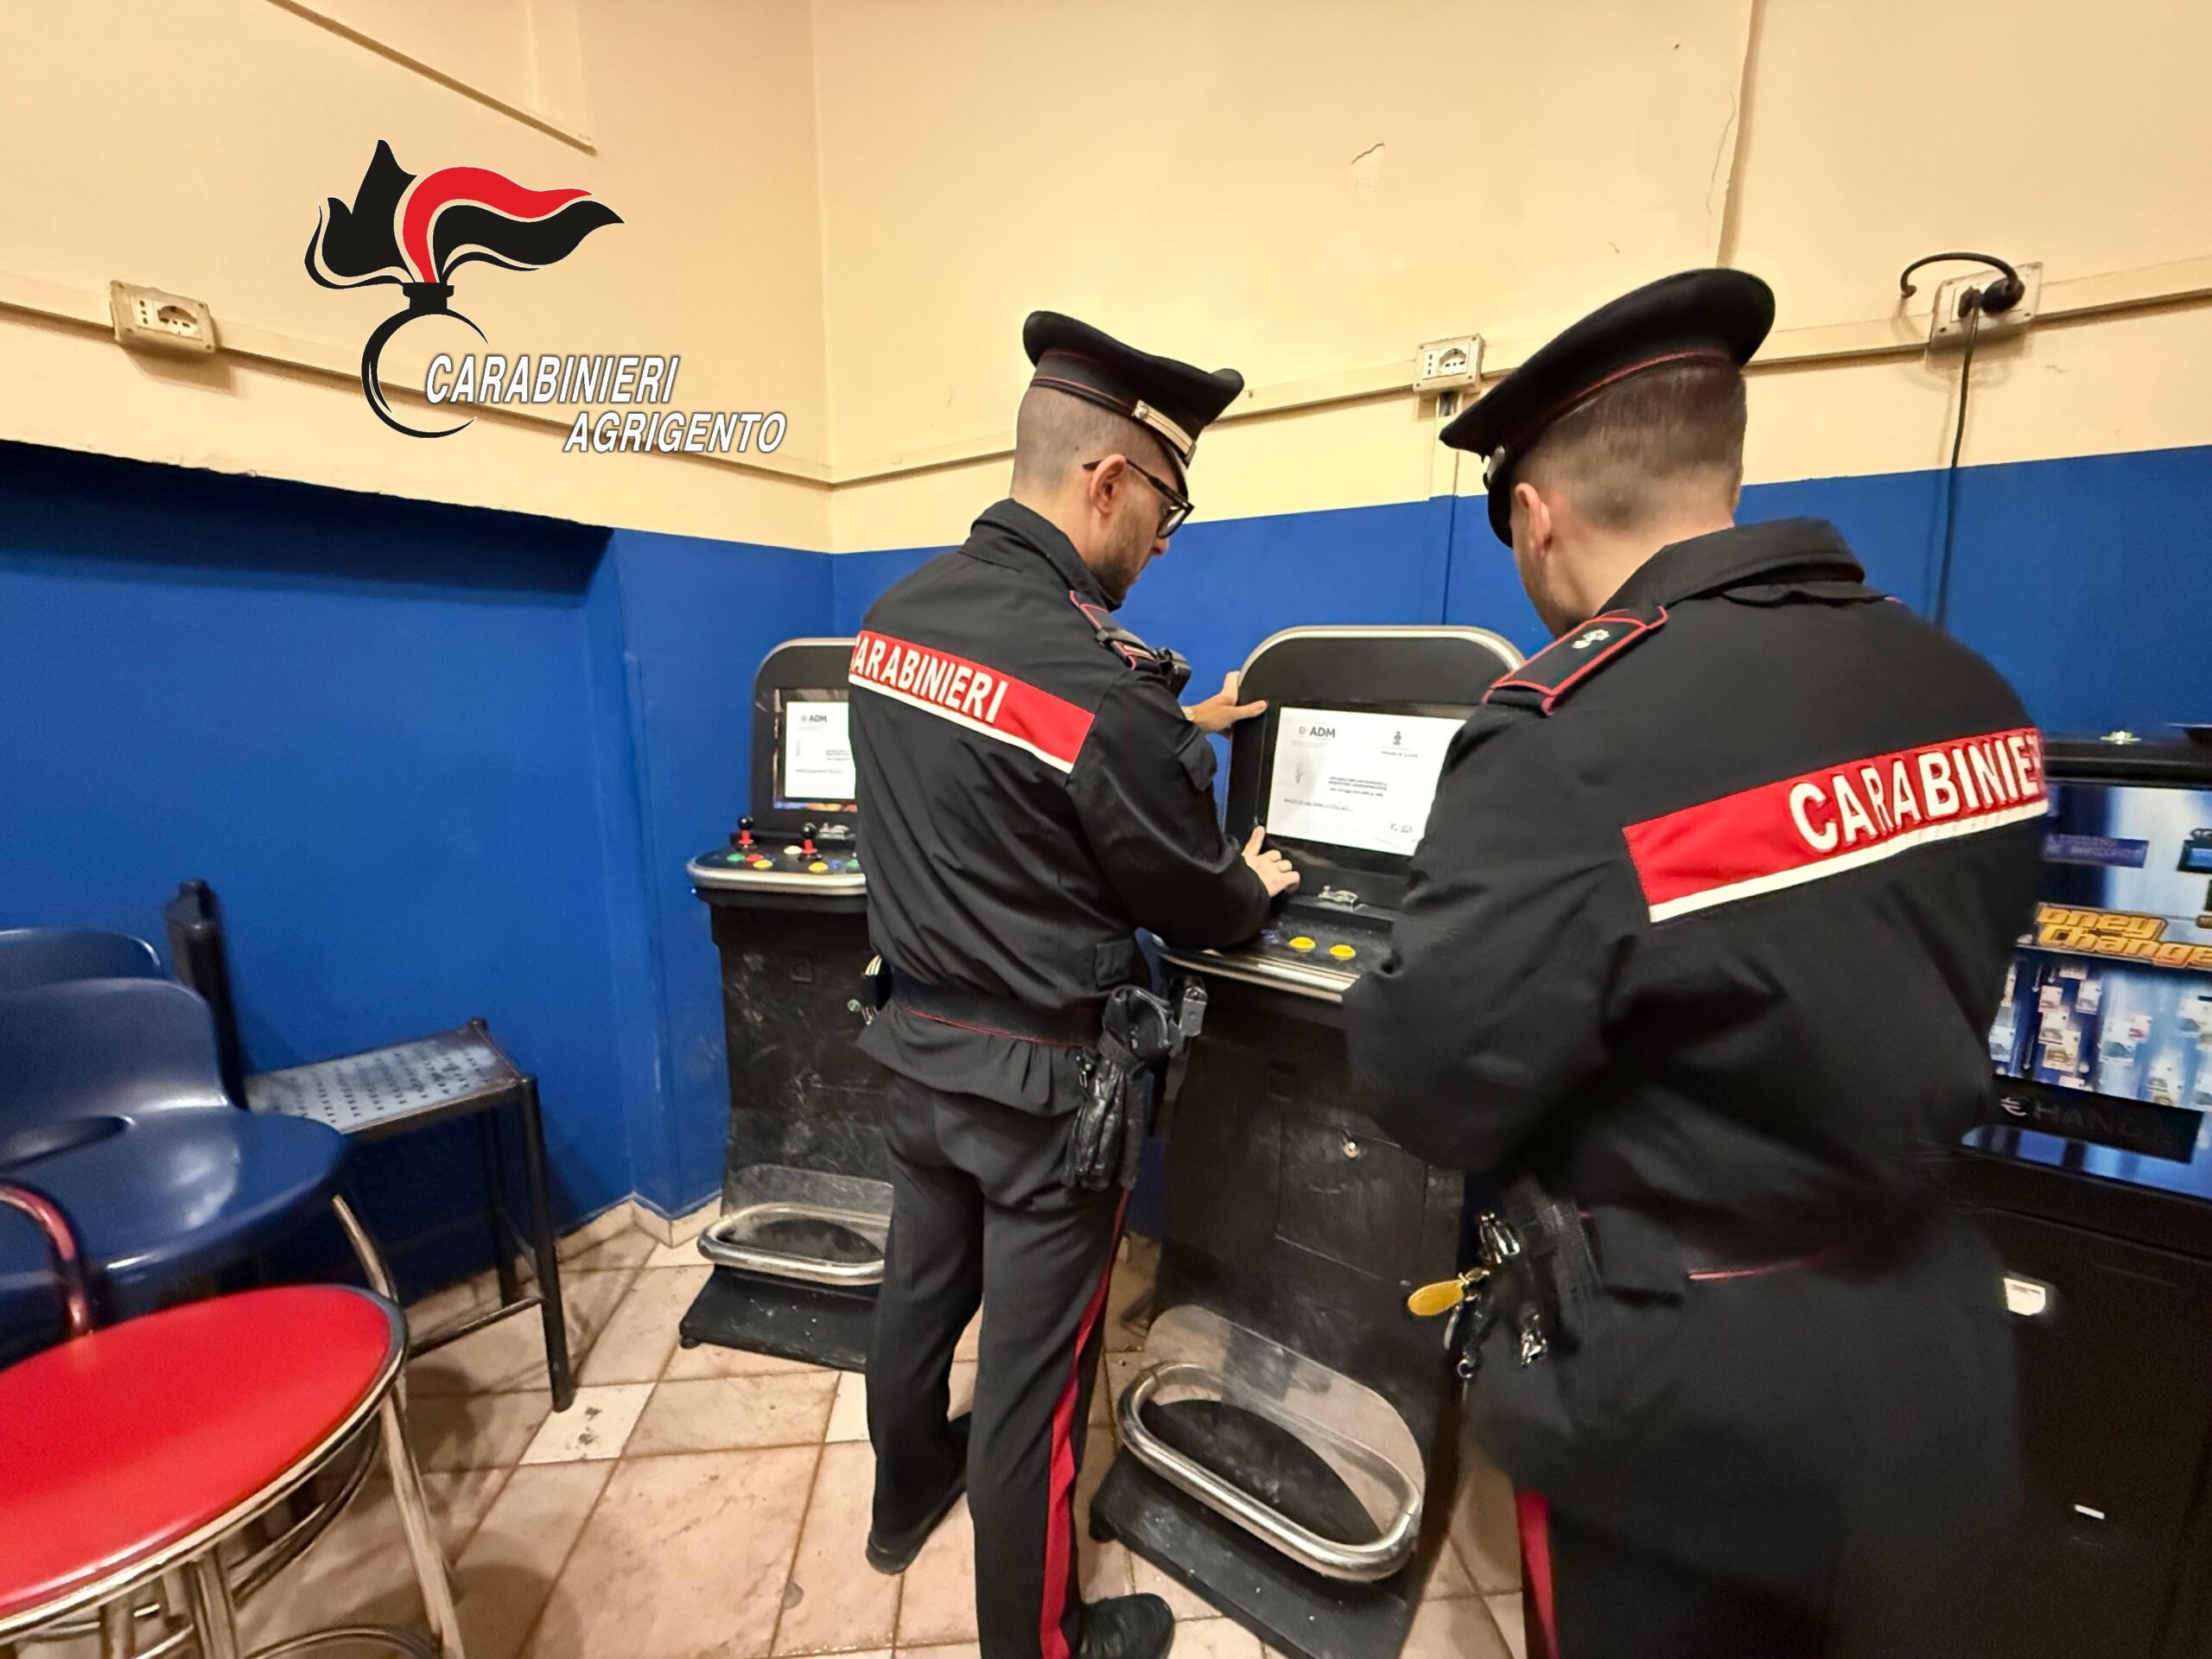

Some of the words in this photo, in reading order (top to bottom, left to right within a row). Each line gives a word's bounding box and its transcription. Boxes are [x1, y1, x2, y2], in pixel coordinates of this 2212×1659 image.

[809, 715, 827, 723] ADM
[1309, 726, 1336, 739] ADM
[2037, 906, 2161, 939] oney
